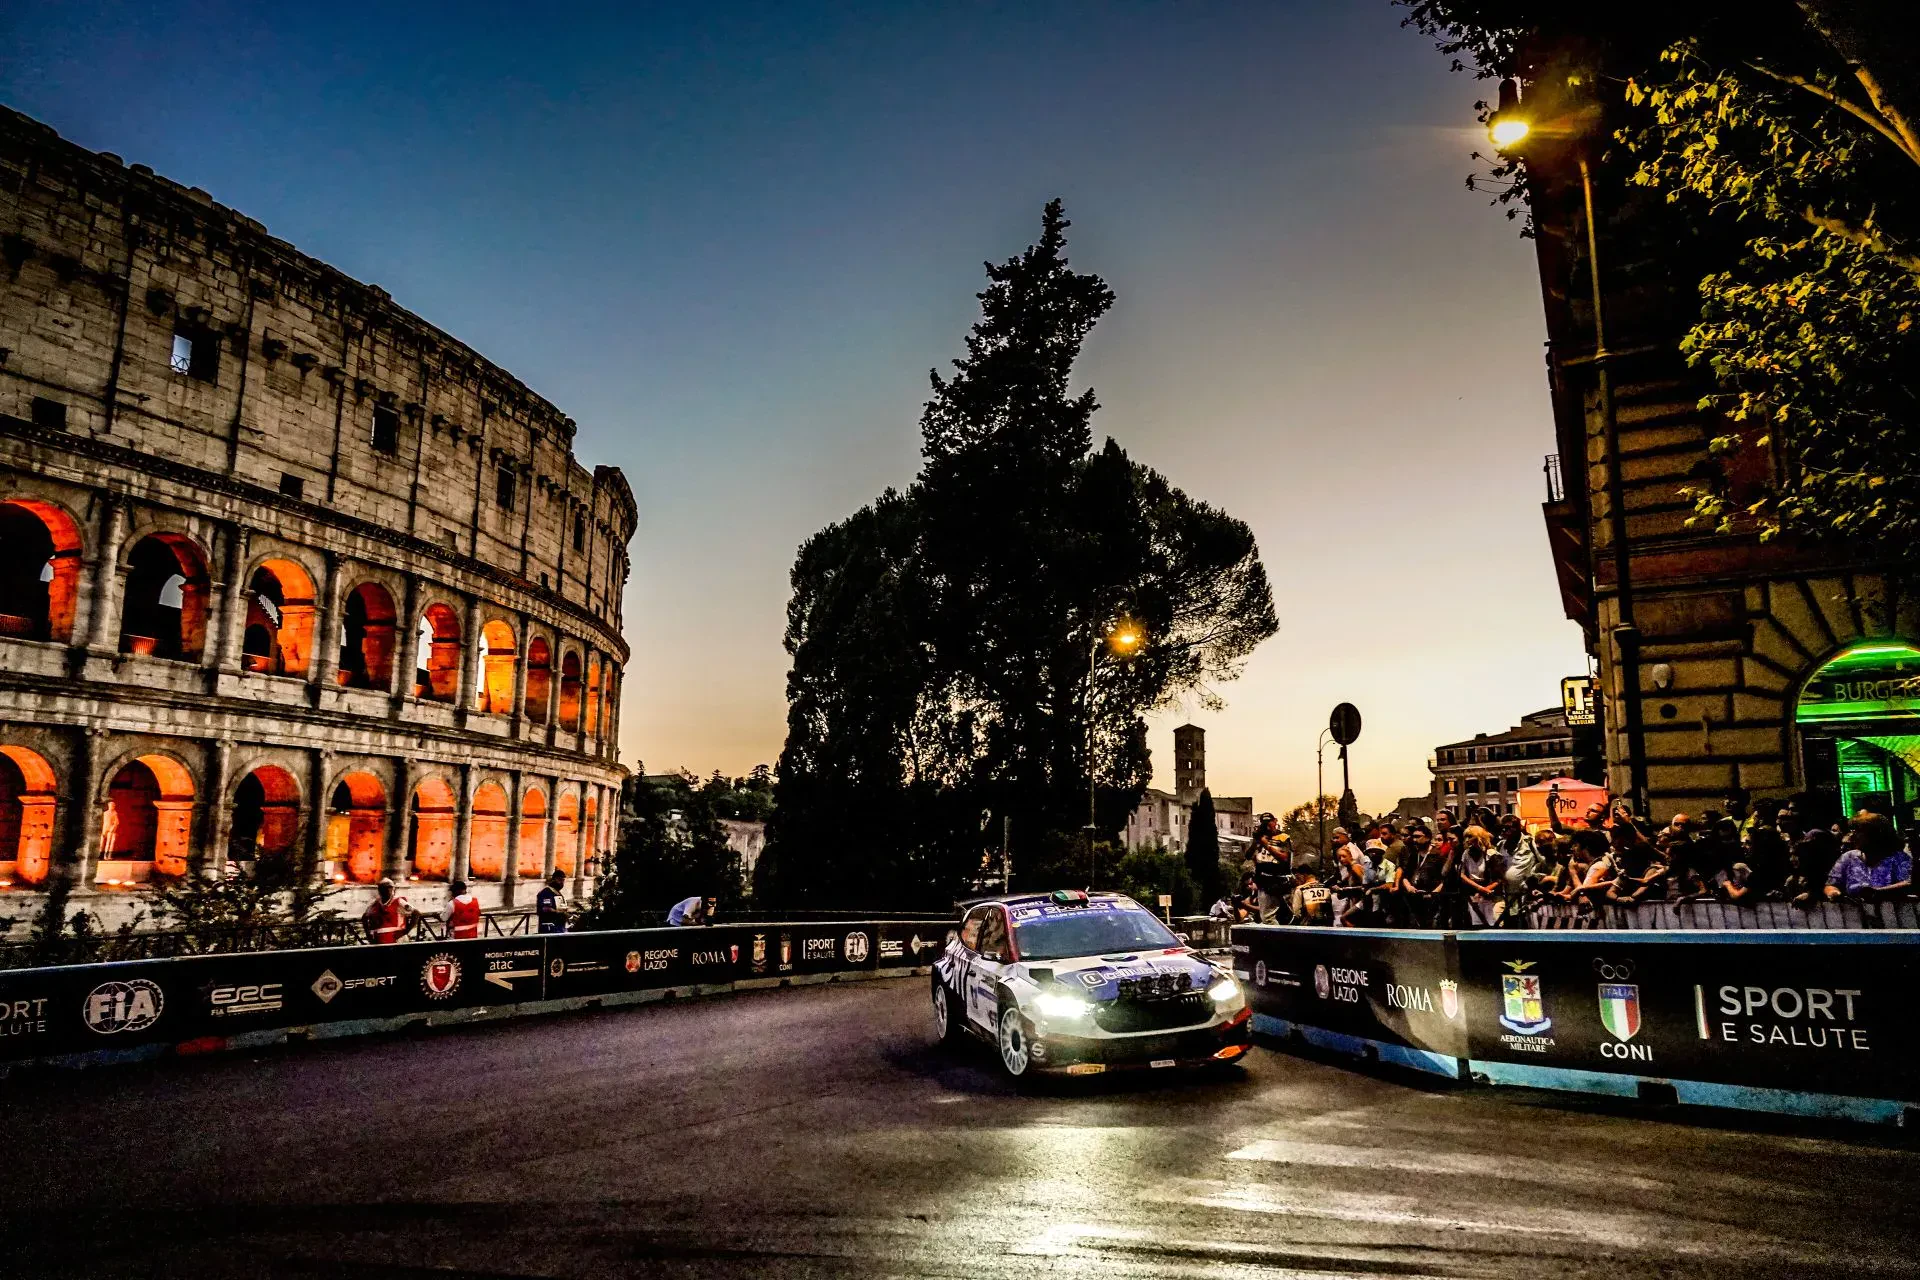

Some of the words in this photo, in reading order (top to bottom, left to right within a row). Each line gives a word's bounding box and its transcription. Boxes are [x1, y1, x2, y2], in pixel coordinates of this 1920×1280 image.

[1309, 889, 1325, 898] 267
[807, 938, 836, 950] SPORT
[644, 948, 679, 960] REGIONE
[692, 950, 727, 965] ROMA
[489, 960, 514, 971] atac
[644, 960, 668, 971] LAZIO
[344, 976, 398, 990] SPORT
[1331, 967, 1370, 987] REGIONE
[1333, 985, 1359, 1004] LAZIO
[1386, 983, 1435, 1013] ROMA
[1719, 985, 1862, 1021] SPORT
[1500, 1034, 1556, 1047] AERONAUTICA
[1721, 1022, 1738, 1042] E
[1750, 1024, 1870, 1050] SALUTE
[1510, 1042, 1547, 1053] MILITARE
[1599, 1042, 1654, 1062] CONI
